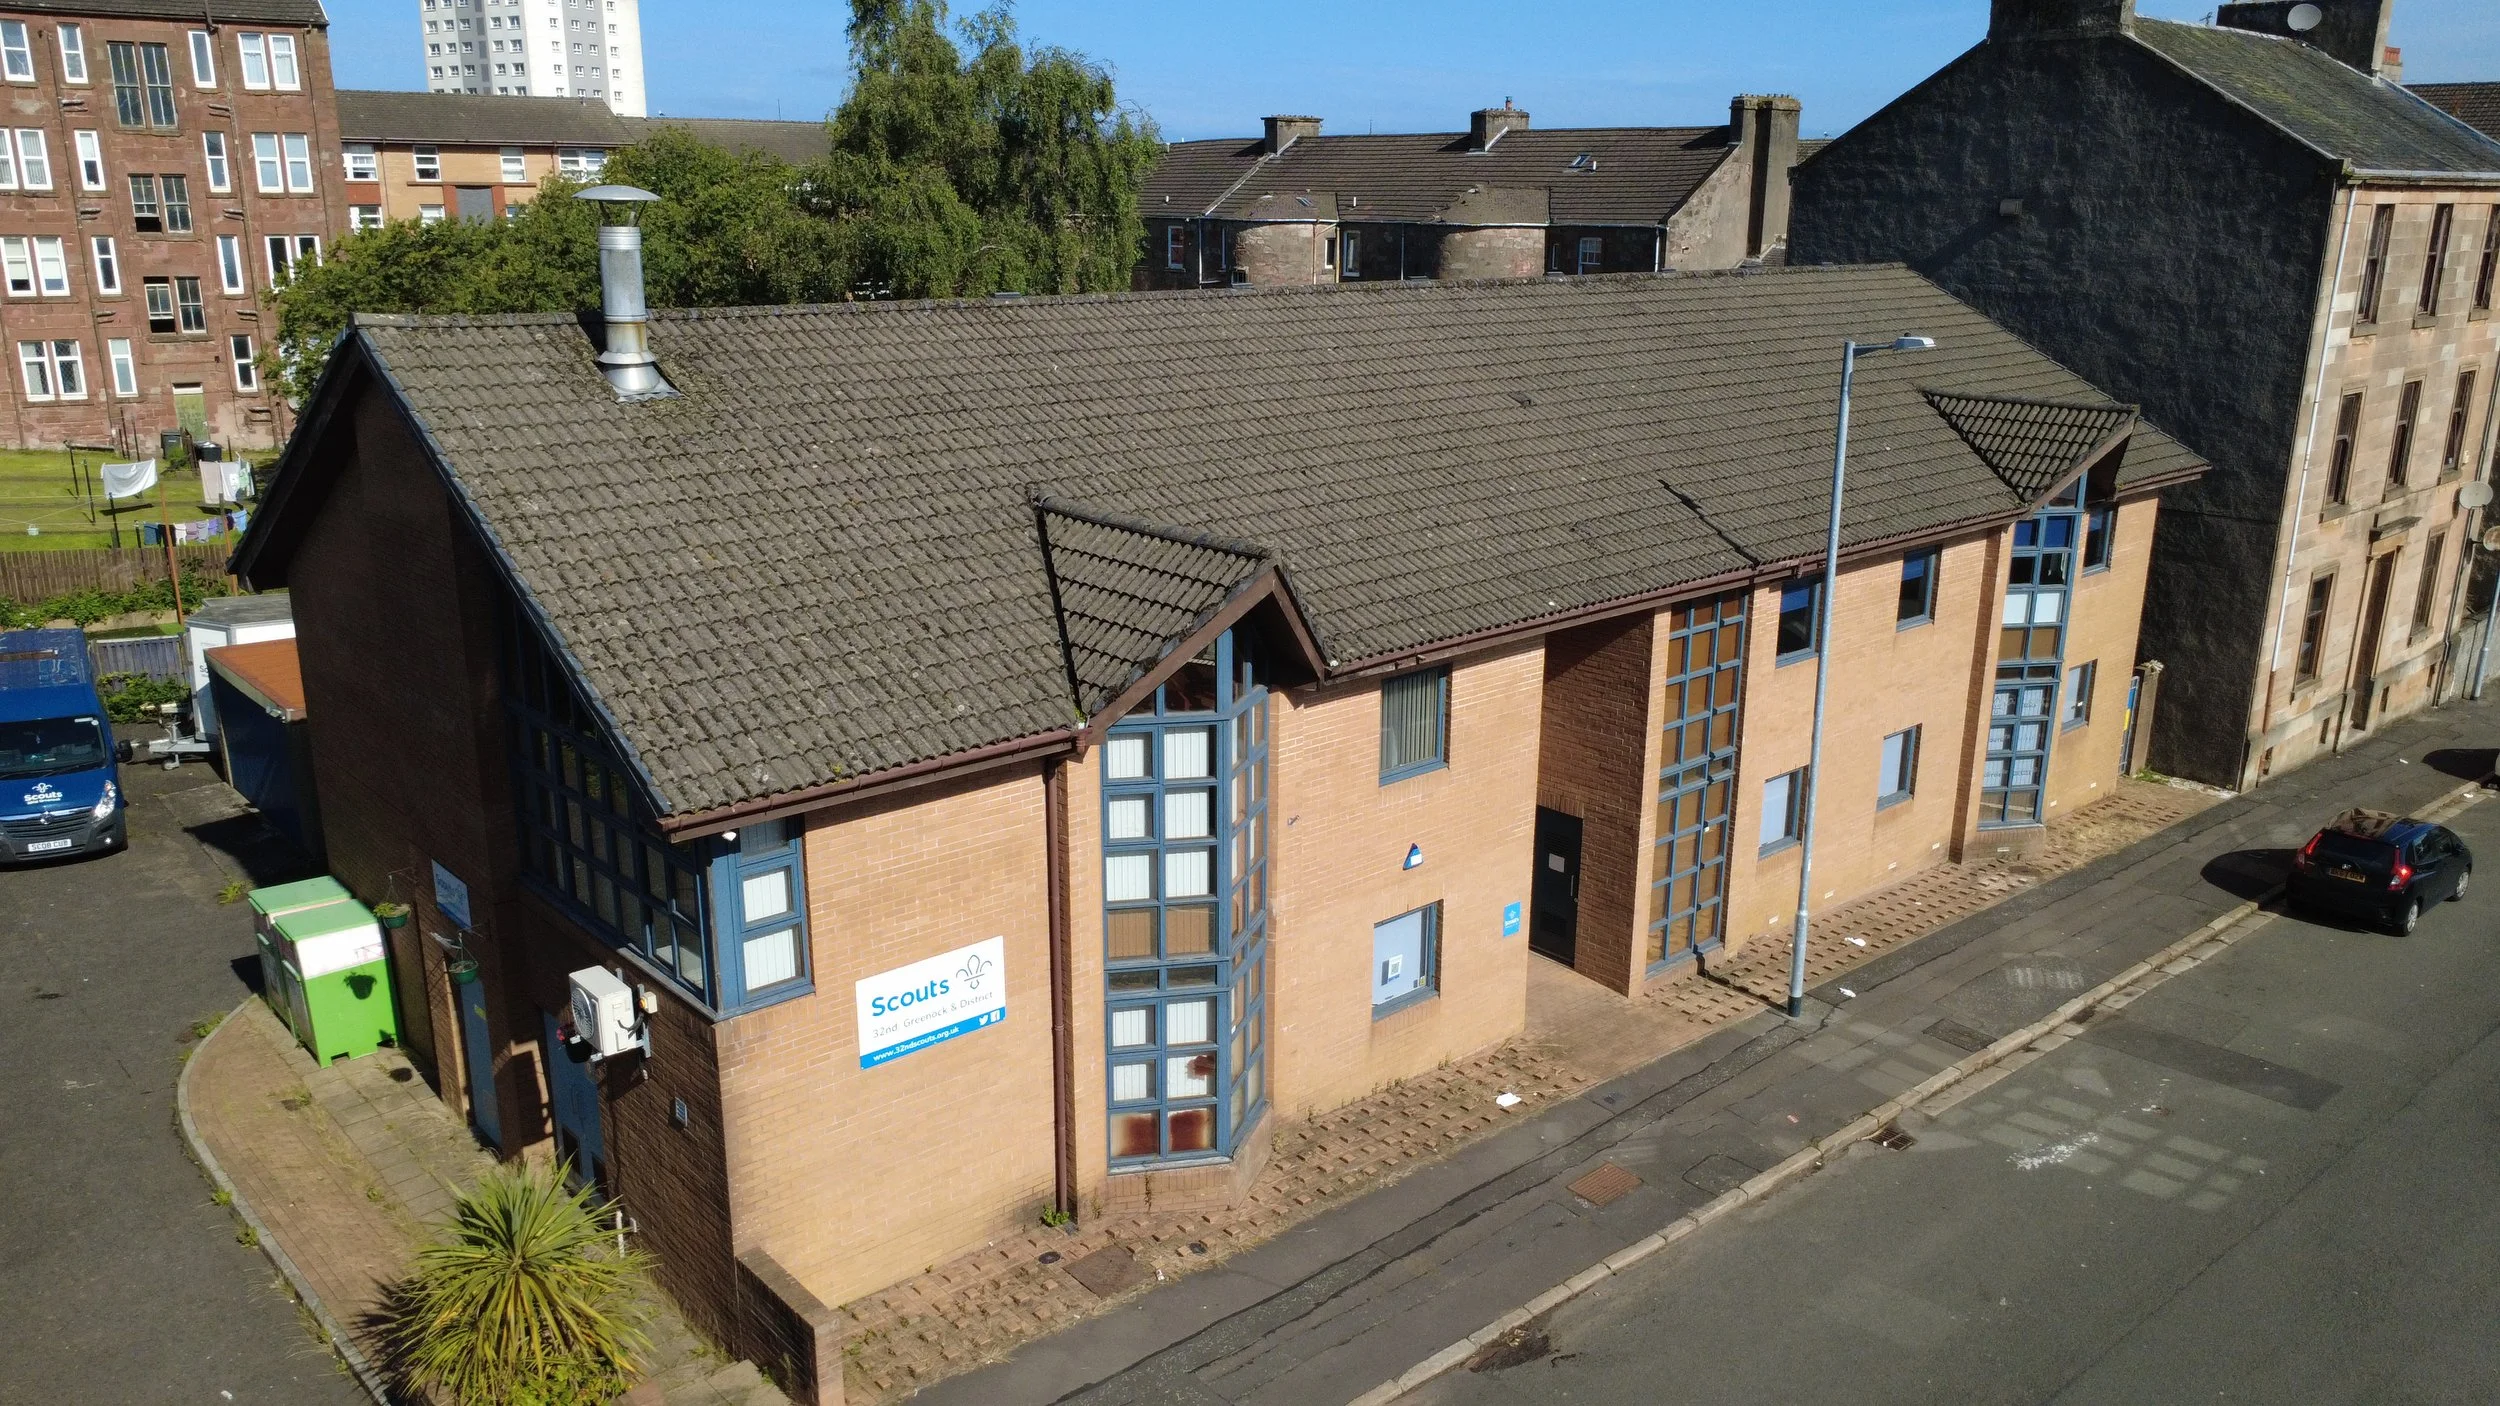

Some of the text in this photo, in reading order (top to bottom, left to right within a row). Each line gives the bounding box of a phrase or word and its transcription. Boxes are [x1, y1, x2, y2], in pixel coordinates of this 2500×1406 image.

[24, 791, 63, 802] Scouts
[871, 978, 950, 1017] Scouts
[872, 991, 994, 1039] 32nd Greenock & District
[872, 1025, 960, 1062] www.32ndscouts.org.uk
